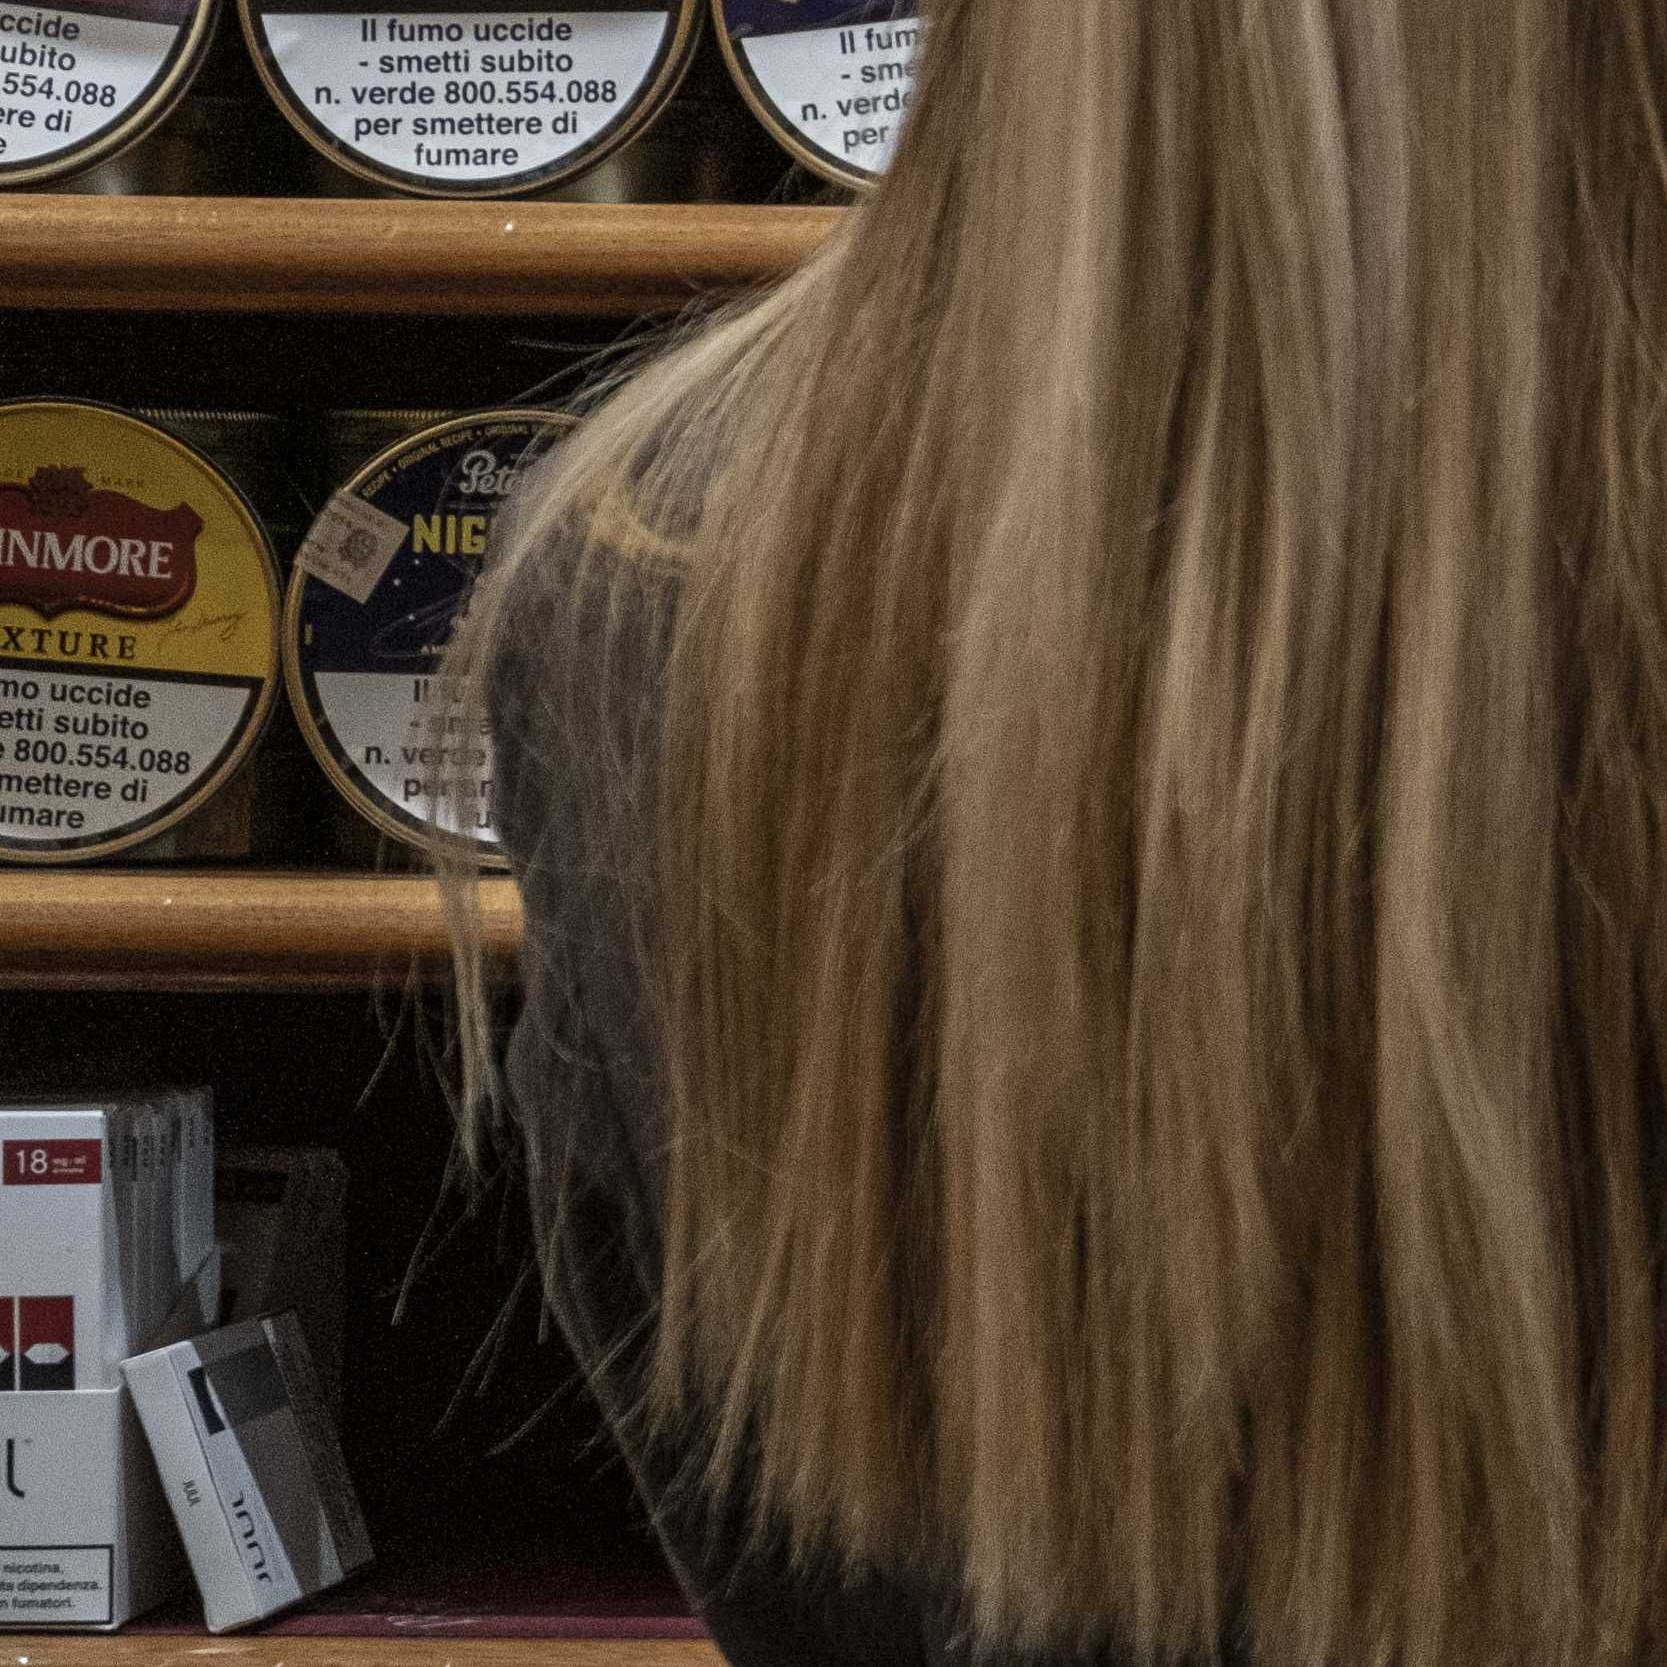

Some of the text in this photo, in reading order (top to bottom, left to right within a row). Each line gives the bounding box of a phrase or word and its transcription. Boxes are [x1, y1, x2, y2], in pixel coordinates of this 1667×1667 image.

[361, 18, 572, 42] Il fumo uccide
[379, 49, 573, 73] smetti subito
[315, 80, 617, 105] n. verde 800.554.088
[354, 111, 578, 141] per smettere di
[415, 144, 519, 166] fumare
[50, 685, 151, 709] uccide
[54, 713, 148, 738] subito
[13, 739, 191, 775] 800.554.088
[14, 1148, 49, 1175] 18
